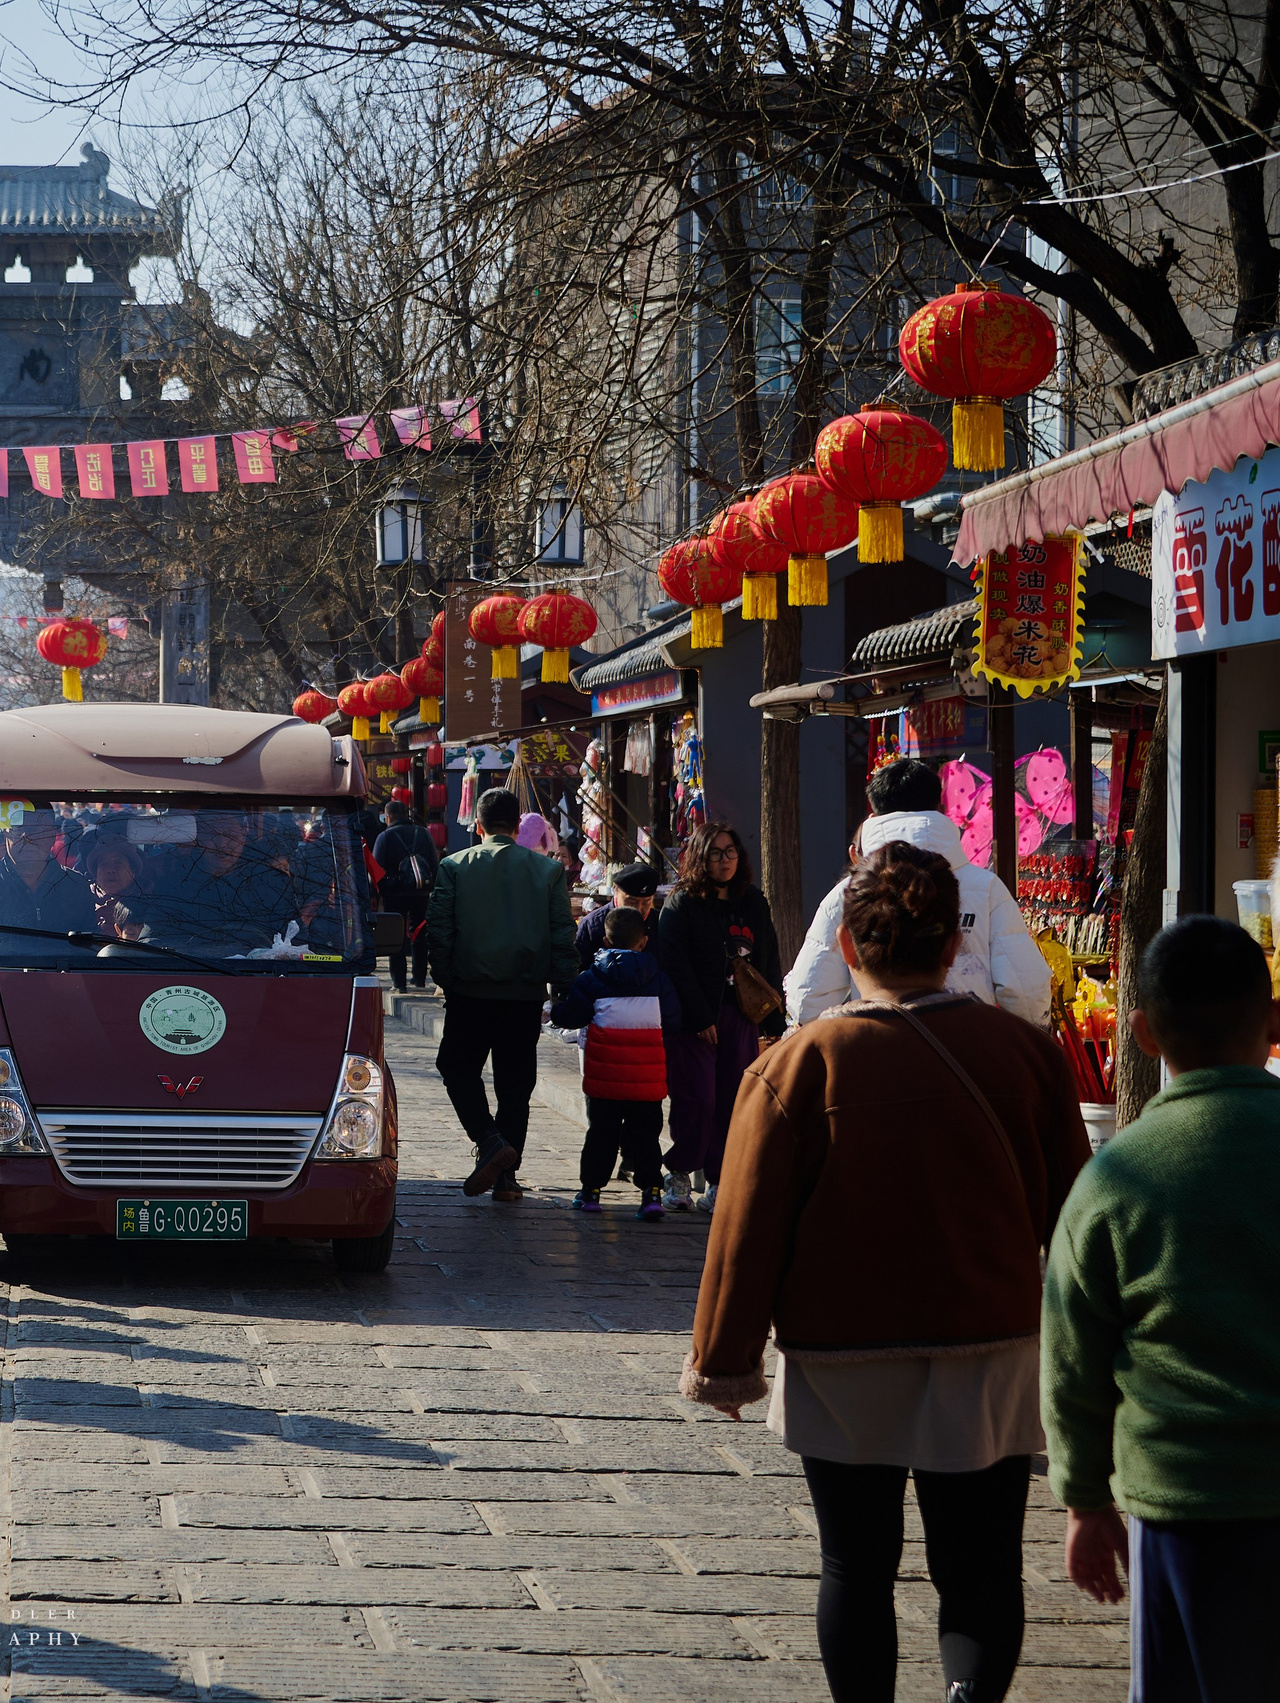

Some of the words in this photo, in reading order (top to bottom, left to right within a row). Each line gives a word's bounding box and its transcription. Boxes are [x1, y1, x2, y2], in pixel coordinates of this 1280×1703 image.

[1013, 544, 1047, 666] 奶油爆米花
[1051, 582, 1068, 650] 奶香酥脆
[463, 637, 477, 703] 南巷一号
[122, 1207, 135, 1232] 场内
